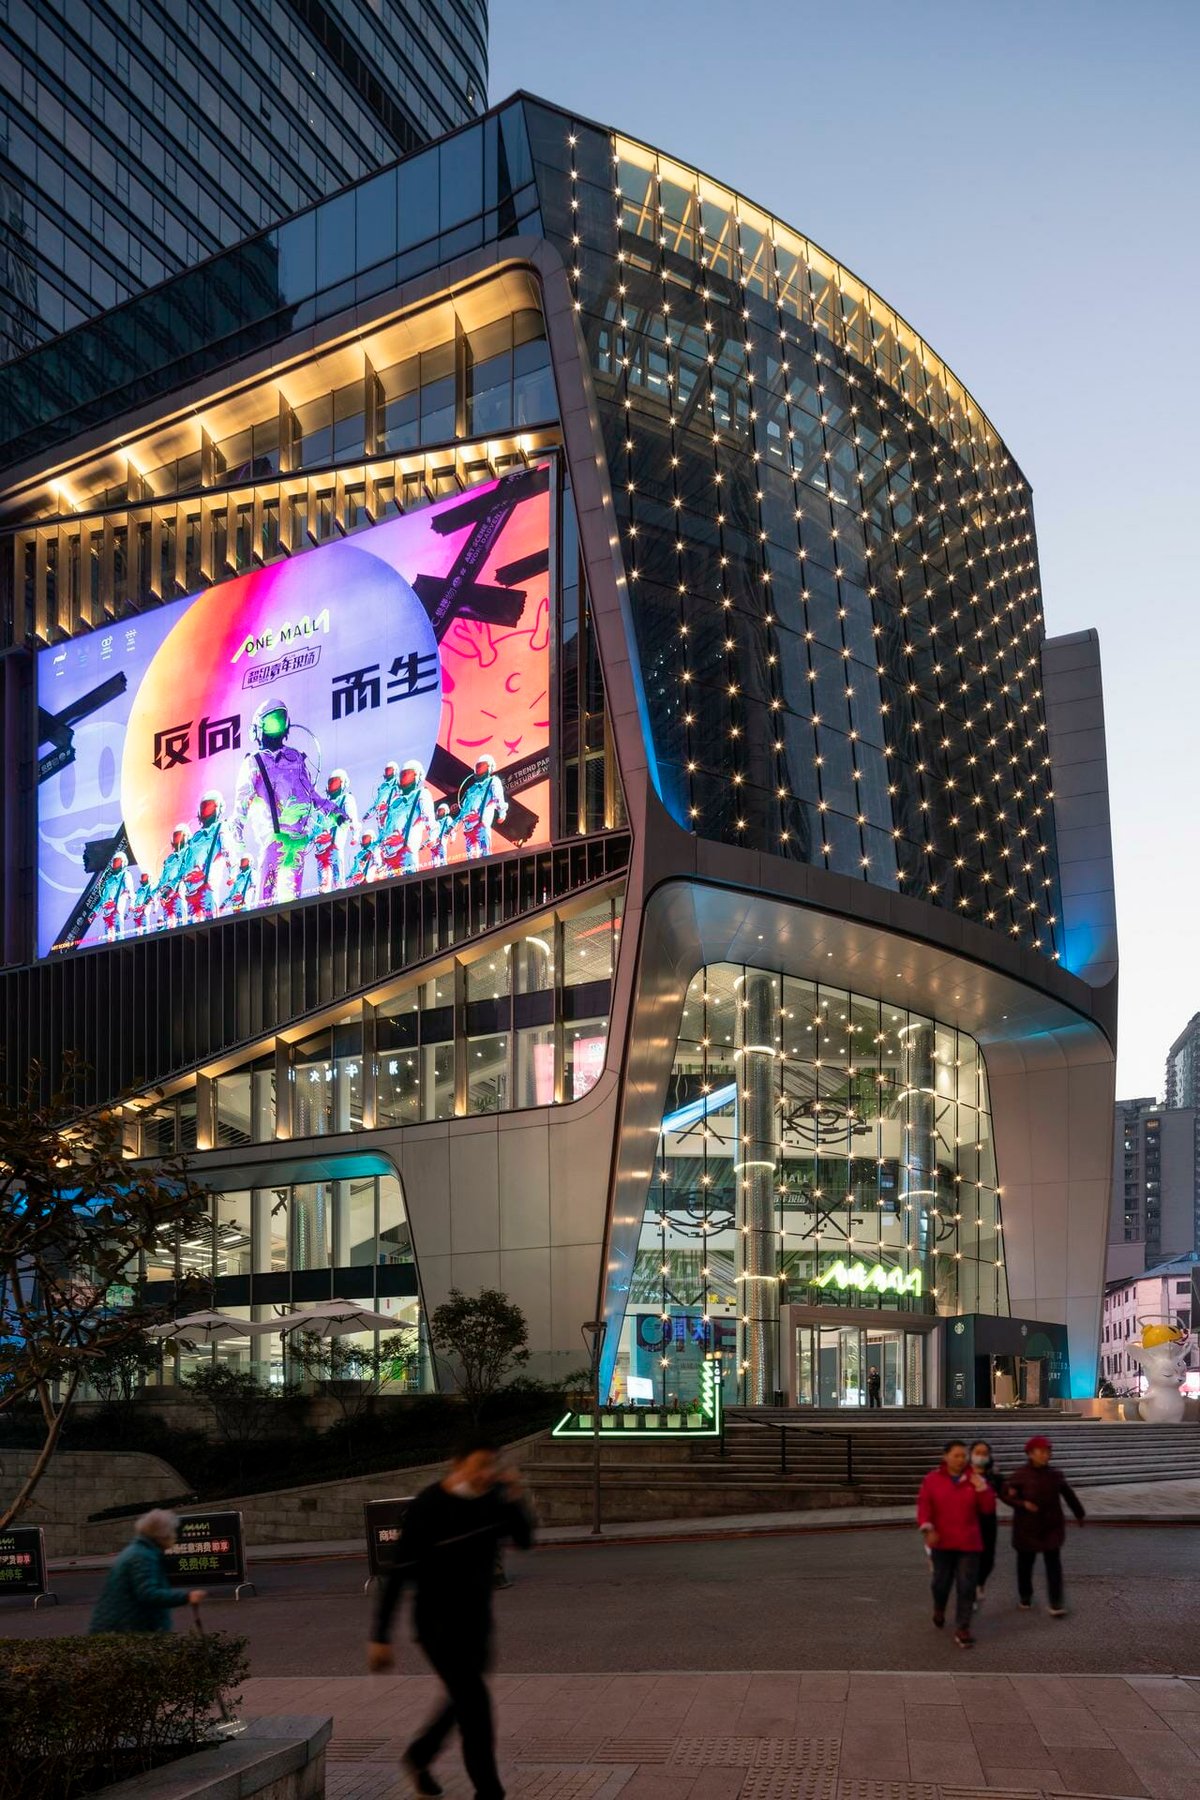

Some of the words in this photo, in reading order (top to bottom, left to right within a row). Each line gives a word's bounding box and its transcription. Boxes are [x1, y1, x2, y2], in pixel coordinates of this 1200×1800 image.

[245, 634, 273, 653] ONE
[279, 619, 319, 642] MALL
[331, 651, 439, 721] 而生
[152, 713, 241, 771] 反向
[514, 764, 537, 779] TREND
[178, 1556, 220, 1571] 免费停车
